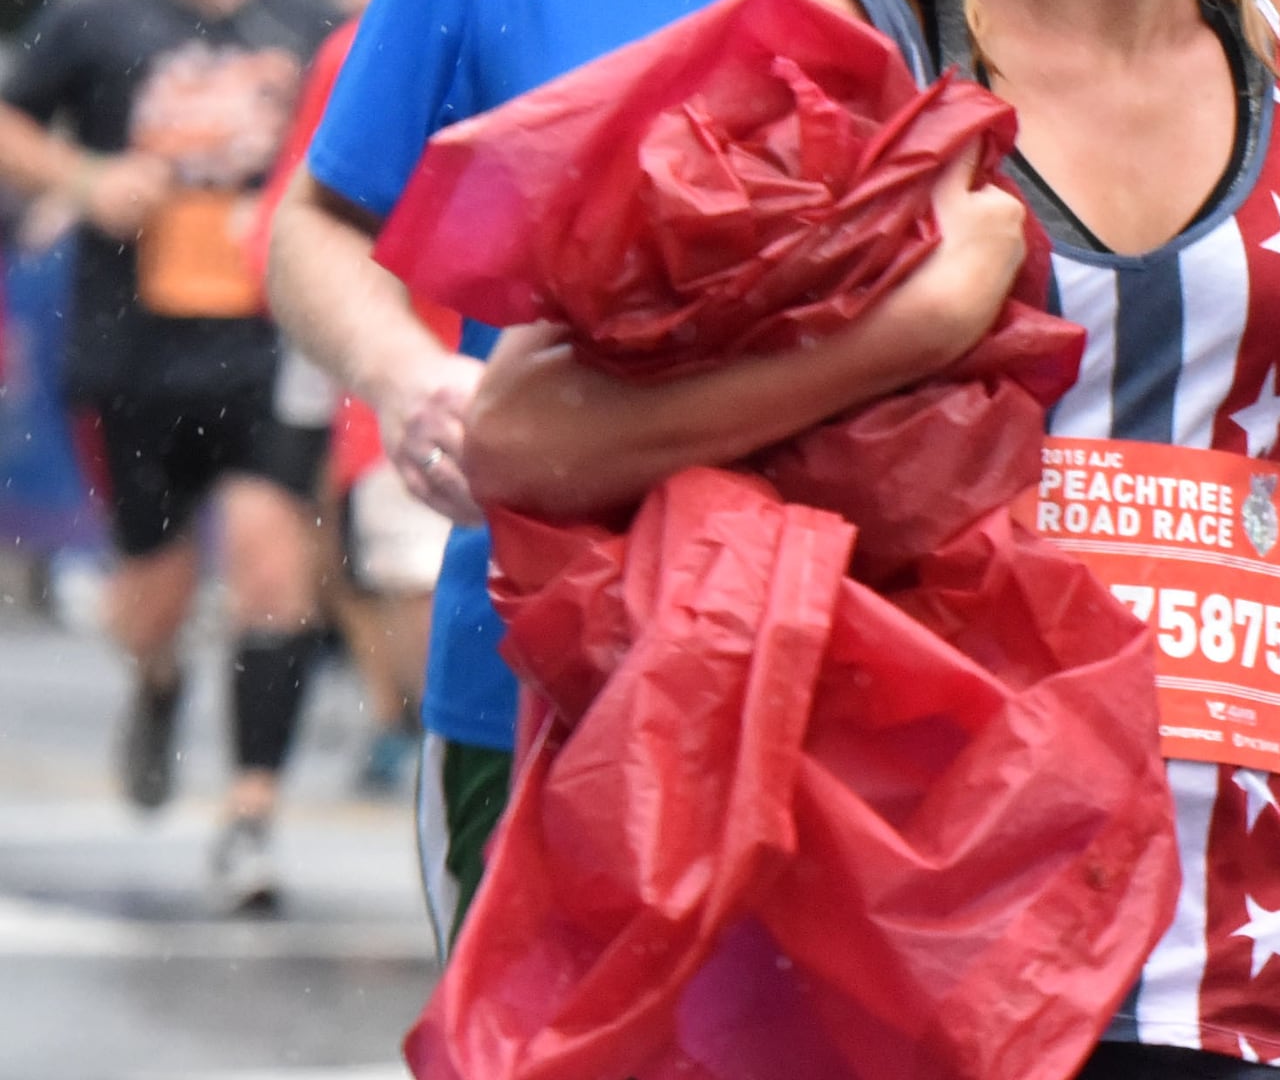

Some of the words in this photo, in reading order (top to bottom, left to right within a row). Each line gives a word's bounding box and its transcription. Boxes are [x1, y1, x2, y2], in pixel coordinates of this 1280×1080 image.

[1041, 448, 1087, 466] 2015
[1088, 451, 1123, 468] AJC
[1039, 469, 1233, 516] PEACHTREE
[1037, 501, 1141, 537] ROAD
[1152, 509, 1233, 548] RACE
